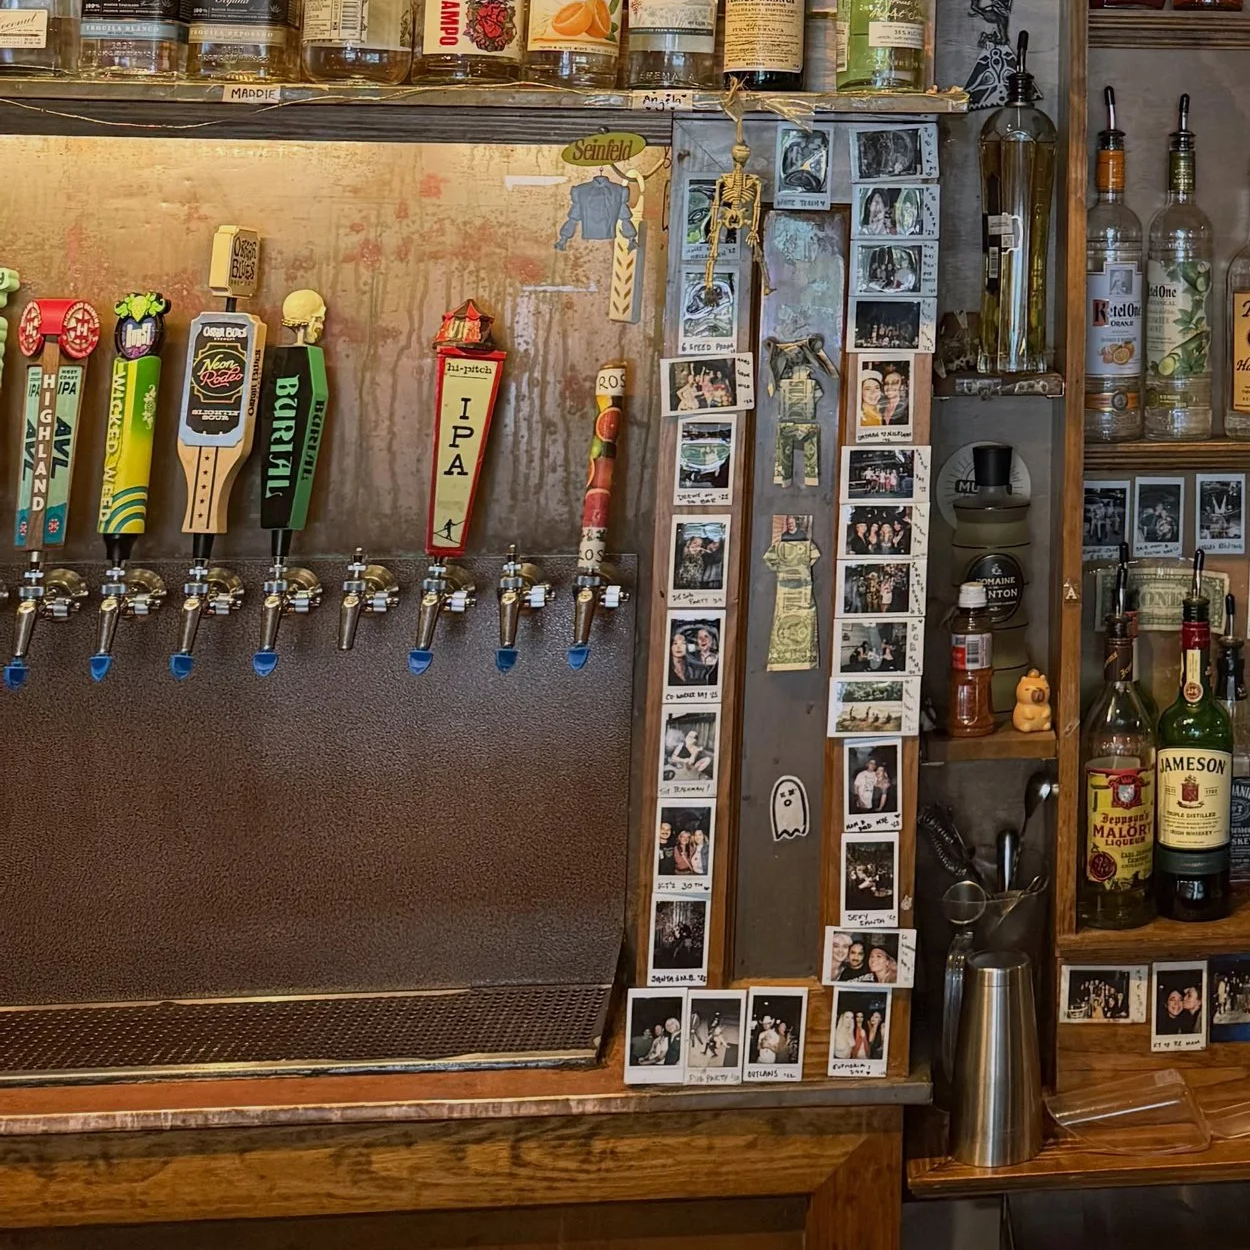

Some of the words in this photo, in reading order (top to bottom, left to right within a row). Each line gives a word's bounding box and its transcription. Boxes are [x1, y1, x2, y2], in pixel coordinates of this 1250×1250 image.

[86, 24, 123, 32] TEQUILA
[125, 25, 160, 33] BLANCO
[231, 88, 276, 100] MADDIE
[572, 137, 633, 162] Seinfeld
[1159, 285, 1177, 298] One
[83, 302, 100, 328] BREWING
[1094, 299, 1126, 324] Ketel
[199, 354, 239, 376] Neon
[445, 360, 493, 375] hi-pitch
[200, 367, 244, 388] Rodeo
[57, 381, 77, 396] IPA
[106, 371, 128, 451] WICKED
[191, 409, 240, 417] SLIGHTLY
[201, 414, 230, 422] SOUR
[31, 374, 57, 512] HIGHLAND
[264, 374, 300, 499] BURIAL
[443, 397, 475, 477] IPA
[50, 415, 73, 480] AVL
[99, 455, 118, 523] WEED
[1159, 757, 1227, 775] JAMESON
[1186, 811, 1217, 819] DISTILLED
[1105, 836, 1146, 847] LIQUEUR
